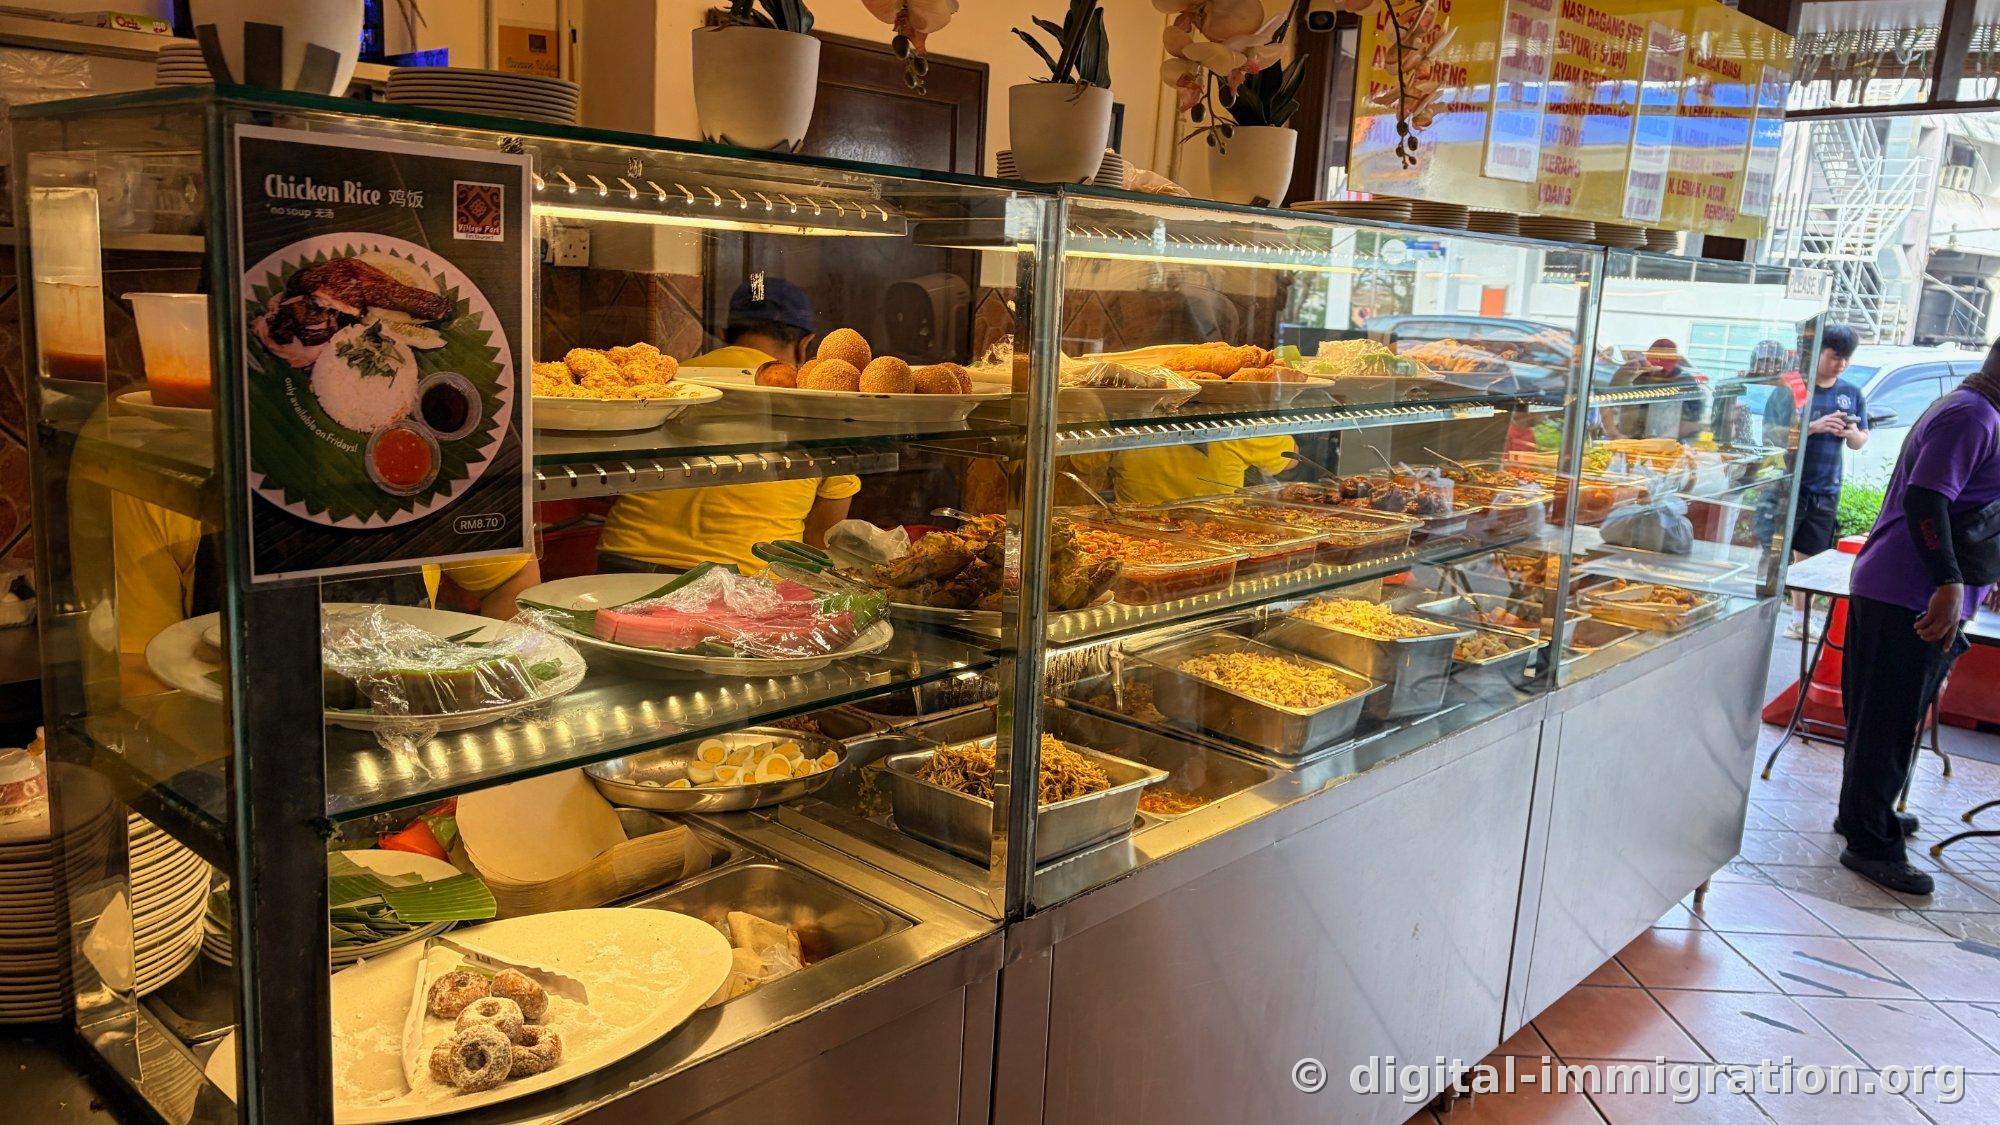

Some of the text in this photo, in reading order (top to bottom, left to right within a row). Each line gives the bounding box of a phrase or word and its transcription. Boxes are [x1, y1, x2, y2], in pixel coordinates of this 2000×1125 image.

[1562, 0, 1586, 24] NASI
[1587, 8, 1625, 38] DAGANG
[1552, 62, 1580, 84] AYAM
[1722, 59, 1742, 80] BIASA
[1545, 123, 1585, 147] SOTONG
[1541, 152, 1582, 178] KERANG
[265, 174, 381, 205] Chicken Rice
[388, 189, 424, 209] 鸡饭
[1538, 183, 1572, 205] UDANG
[1676, 179, 1702, 198] LEMAK
[1707, 184, 1726, 202] AYAM
[286, 207, 312, 219] soup
[284, 377, 359, 453] only available on Fridays!
[460, 517, 499, 530] RM8.70
